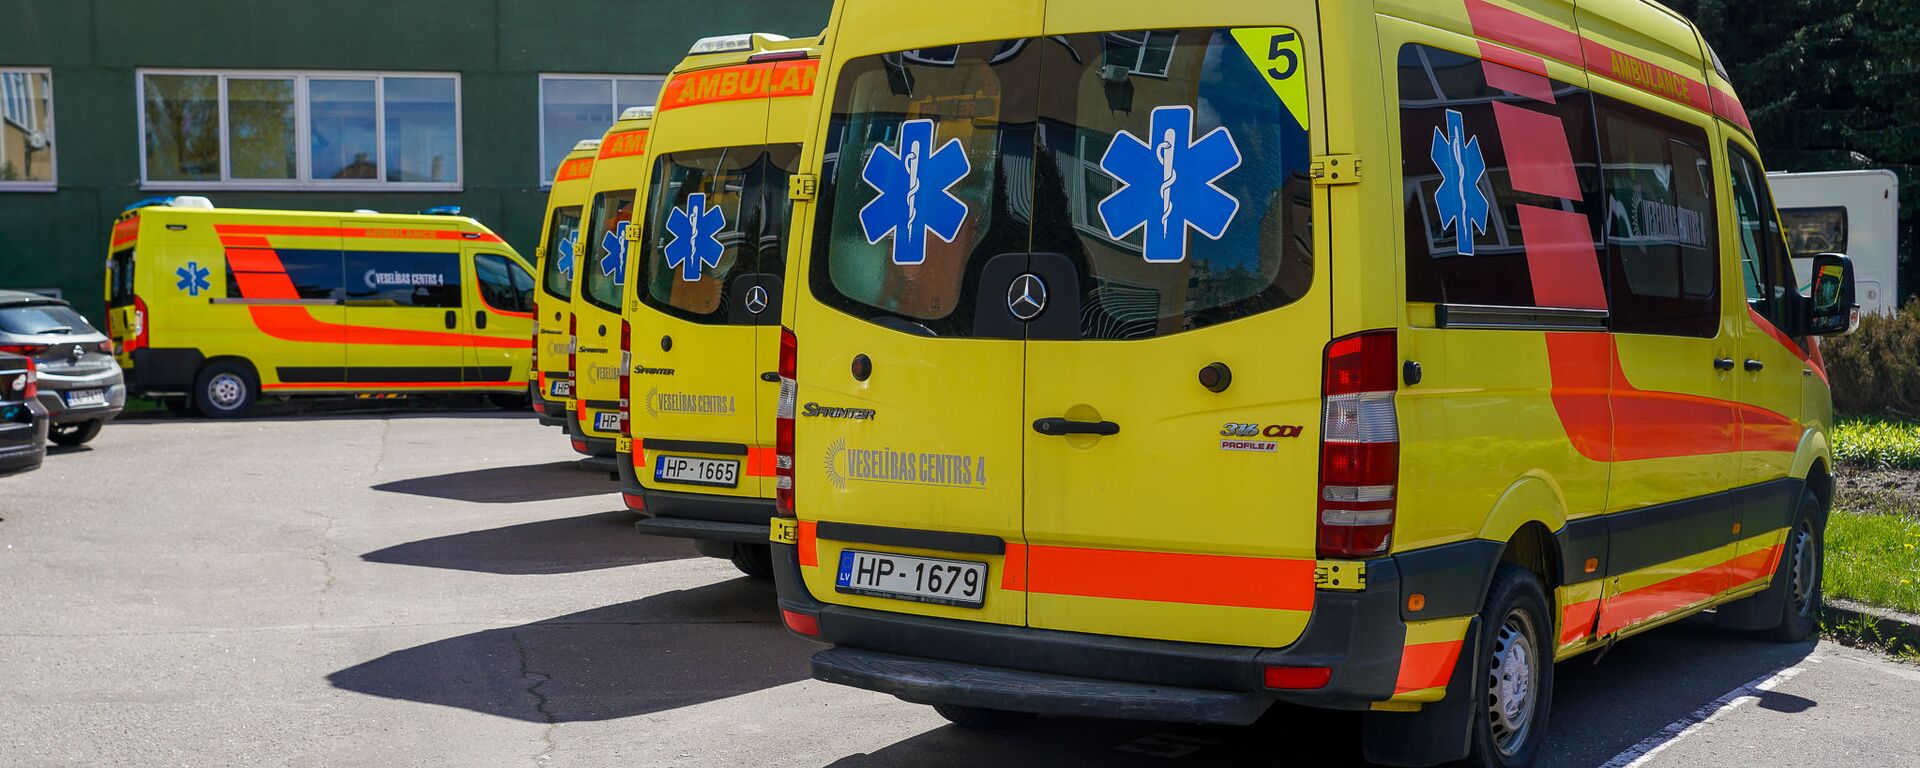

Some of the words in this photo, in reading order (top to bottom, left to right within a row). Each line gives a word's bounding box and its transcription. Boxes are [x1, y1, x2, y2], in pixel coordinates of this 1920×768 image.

[1267, 32, 1298, 80] 5
[1611, 50, 1689, 101] AMBULANCE
[437, 273, 444, 287] 4
[698, 394, 728, 414] CENTRS
[729, 396, 736, 414] 4
[801, 402, 876, 421] SPRINTER
[1220, 422, 1260, 437] 316
[1262, 425, 1303, 438] CDI
[1222, 441, 1265, 450] PROFILE
[919, 452, 972, 486] CENTRS
[975, 456, 987, 486] 4
[840, 572, 850, 581] LV
